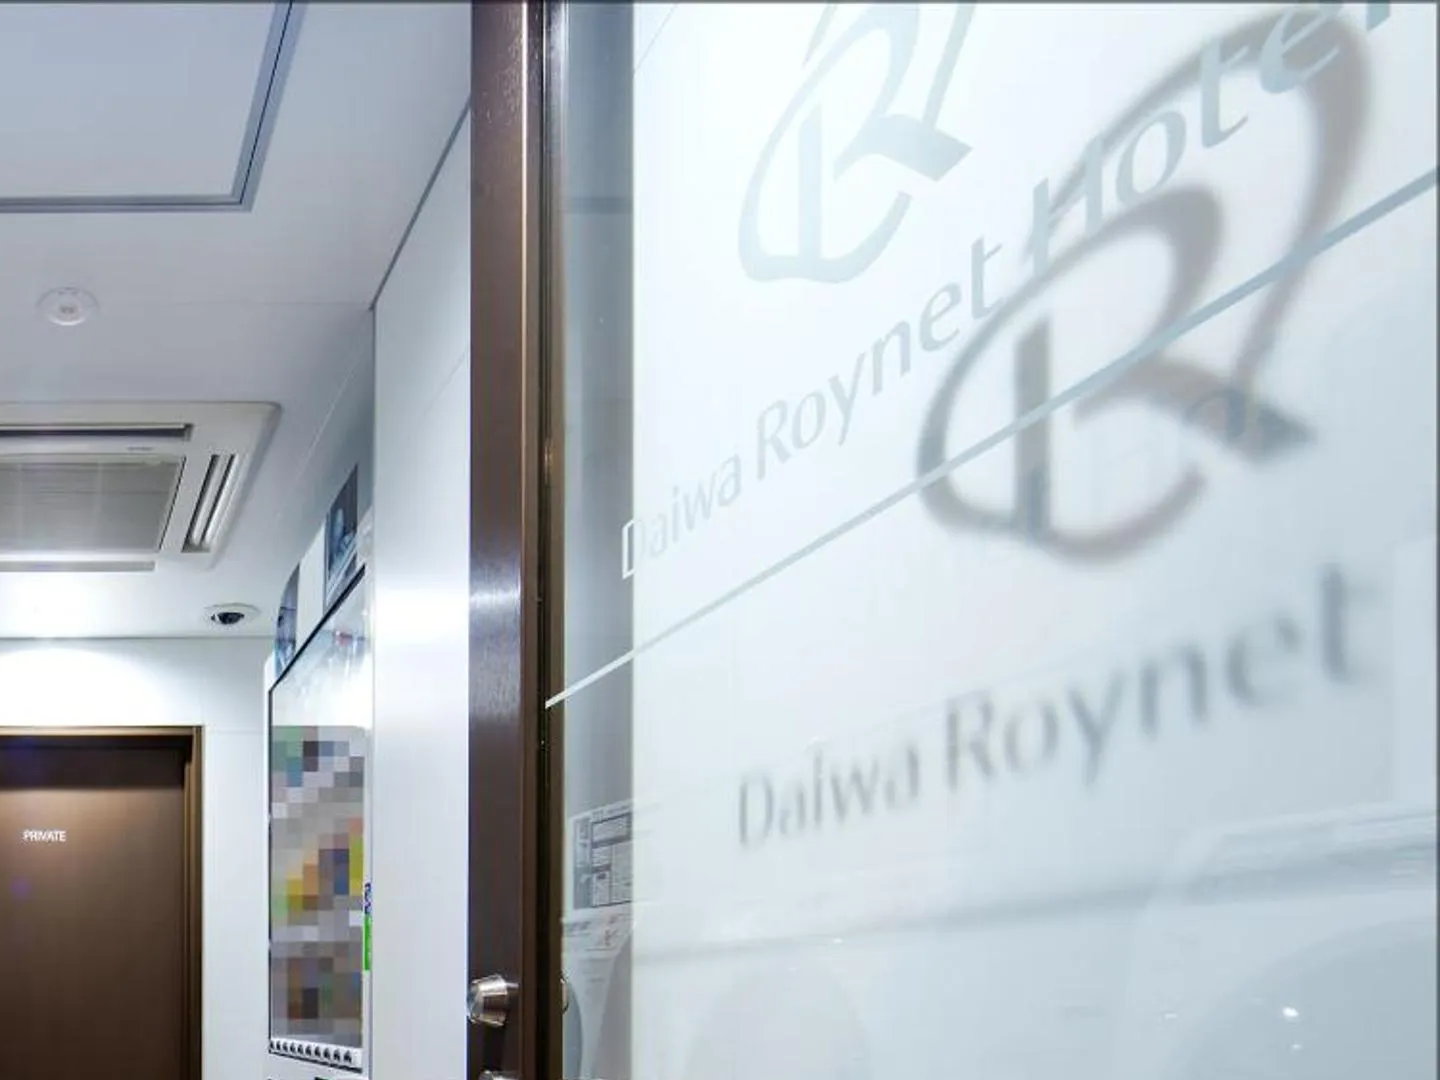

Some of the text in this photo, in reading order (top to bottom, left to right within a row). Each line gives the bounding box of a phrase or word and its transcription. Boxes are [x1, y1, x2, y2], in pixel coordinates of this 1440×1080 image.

[622, 2, 1391, 579] Daiwa Roynet Hote
[23, 830, 66, 843] PRIVATE
